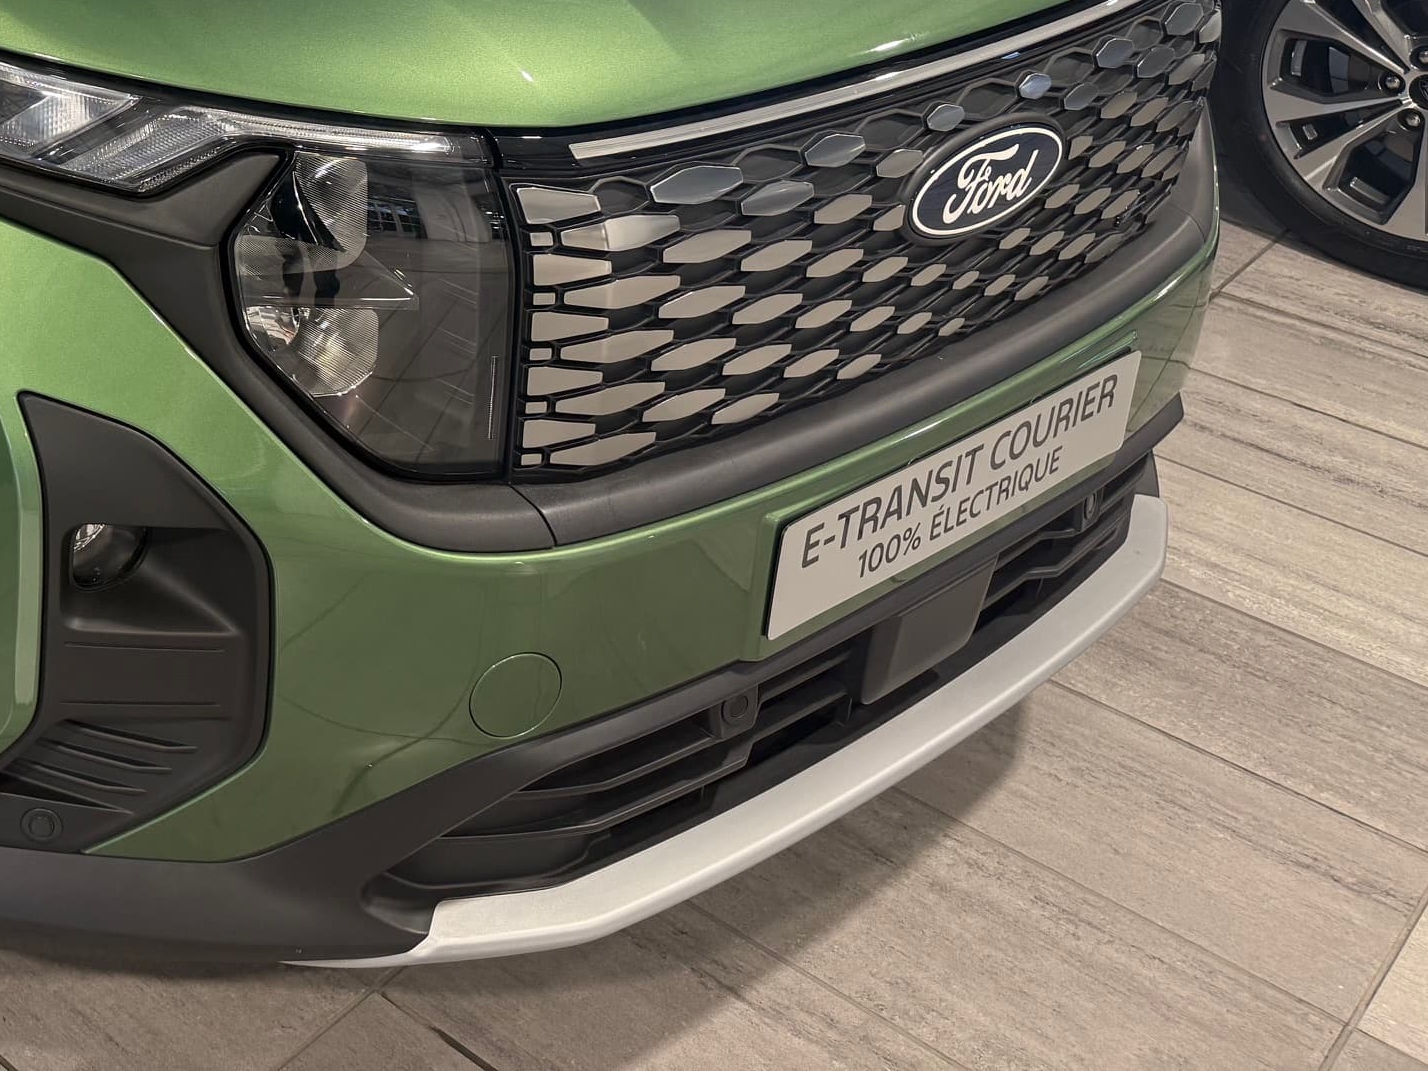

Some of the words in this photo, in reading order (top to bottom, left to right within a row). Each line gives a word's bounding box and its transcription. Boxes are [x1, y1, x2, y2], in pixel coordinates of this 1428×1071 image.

[943, 142, 1035, 224] Ford
[801, 444, 984, 569] E-TRANSIT
[990, 373, 1119, 471] COURIER
[858, 523, 922, 579] 100%
[929, 446, 1063, 541] ÉLECTRIQUE
